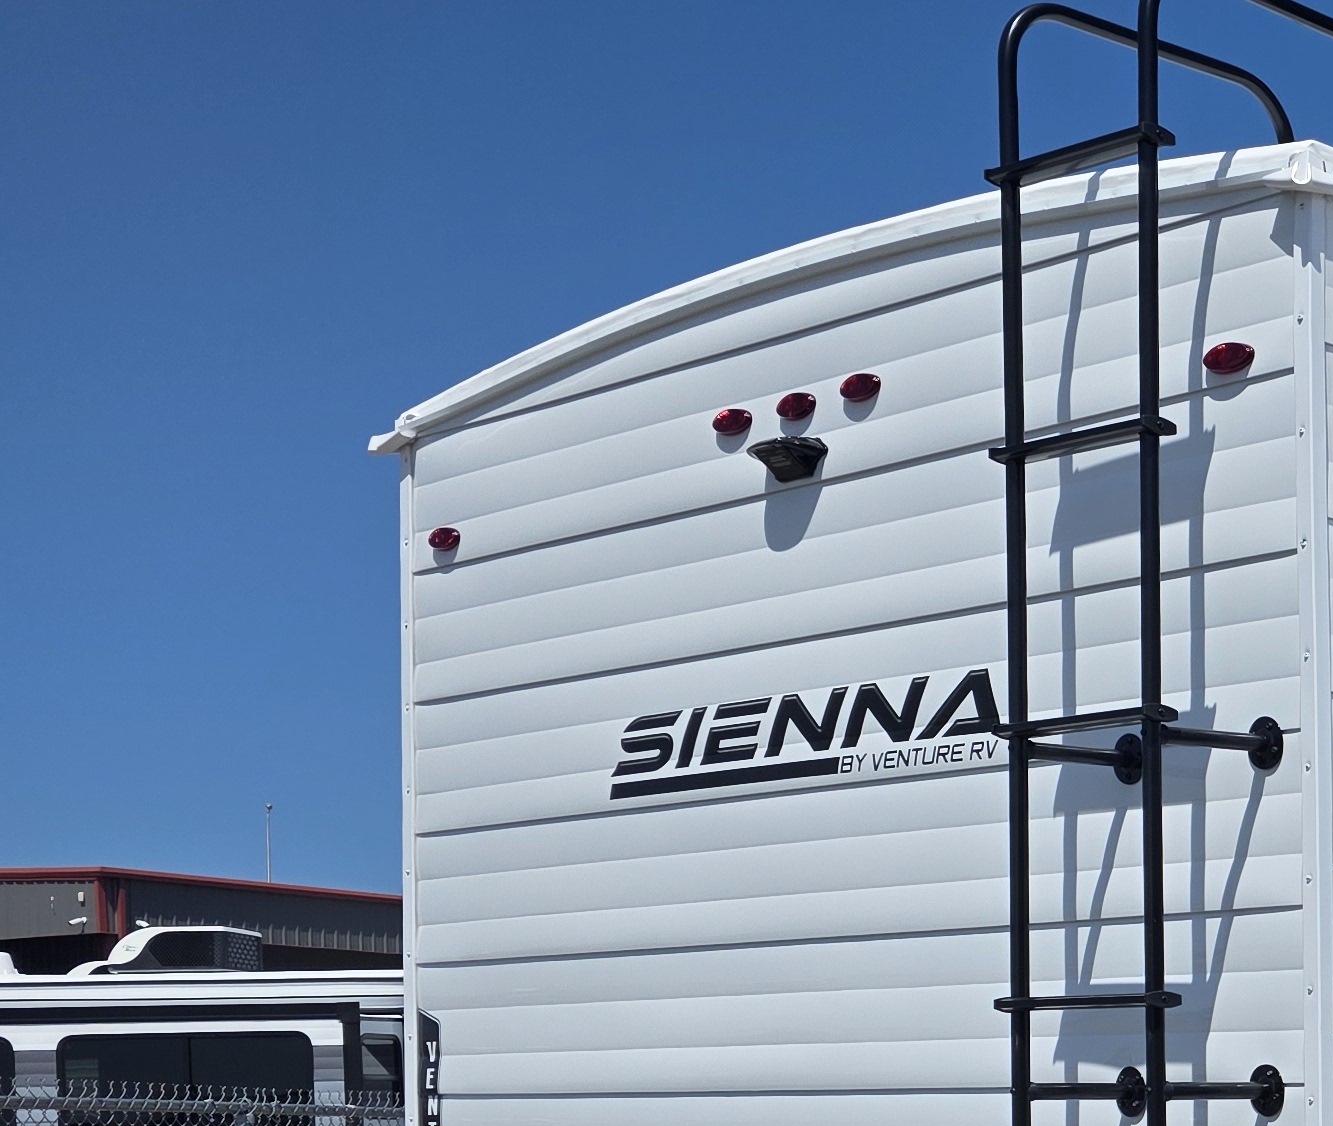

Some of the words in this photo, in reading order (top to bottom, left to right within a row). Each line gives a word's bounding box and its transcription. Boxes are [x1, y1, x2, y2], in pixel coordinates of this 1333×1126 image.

[611, 668, 1001, 777] SIENNA
[839, 752, 864, 775] BY
[871, 740, 966, 773] VENTURE
[969, 738, 999, 763] RV
